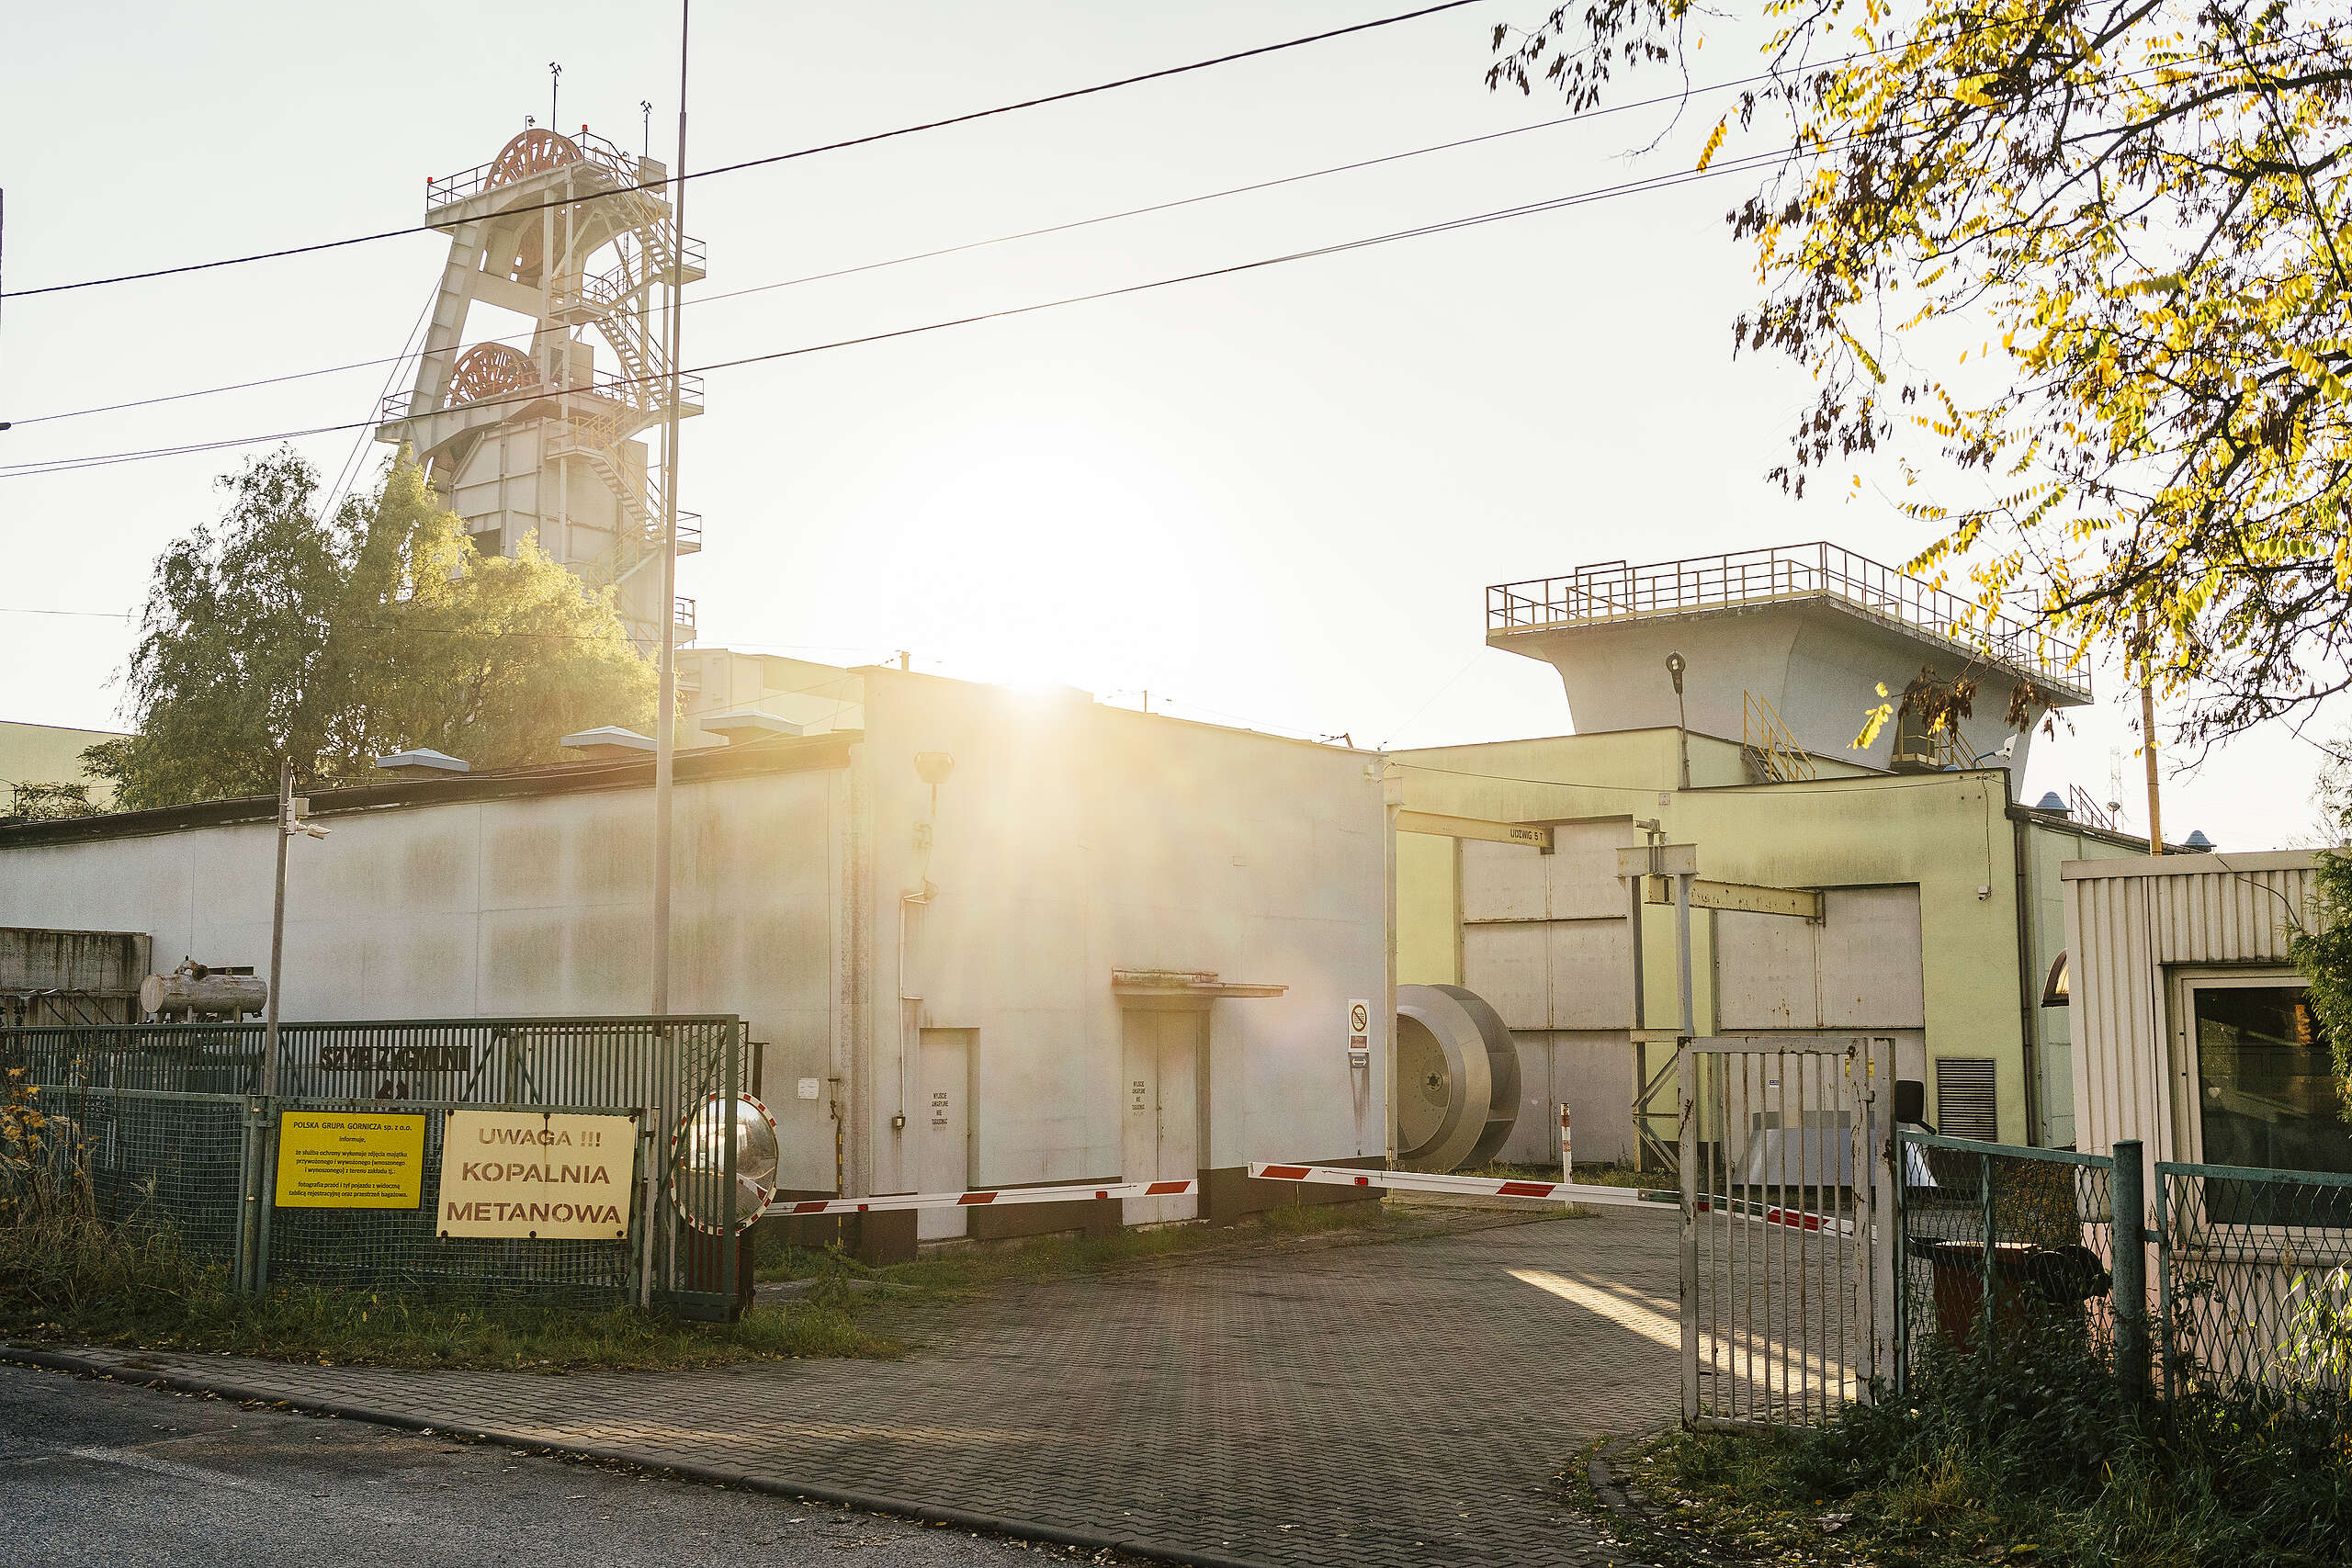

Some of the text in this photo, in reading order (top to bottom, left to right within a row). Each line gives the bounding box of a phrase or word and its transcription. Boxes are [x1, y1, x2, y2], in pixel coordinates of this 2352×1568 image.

[479, 1127, 602, 1147] UWAGA !!!
[461, 1162, 610, 1185] KOPALNIA
[447, 1201, 622, 1224] METANOWA
